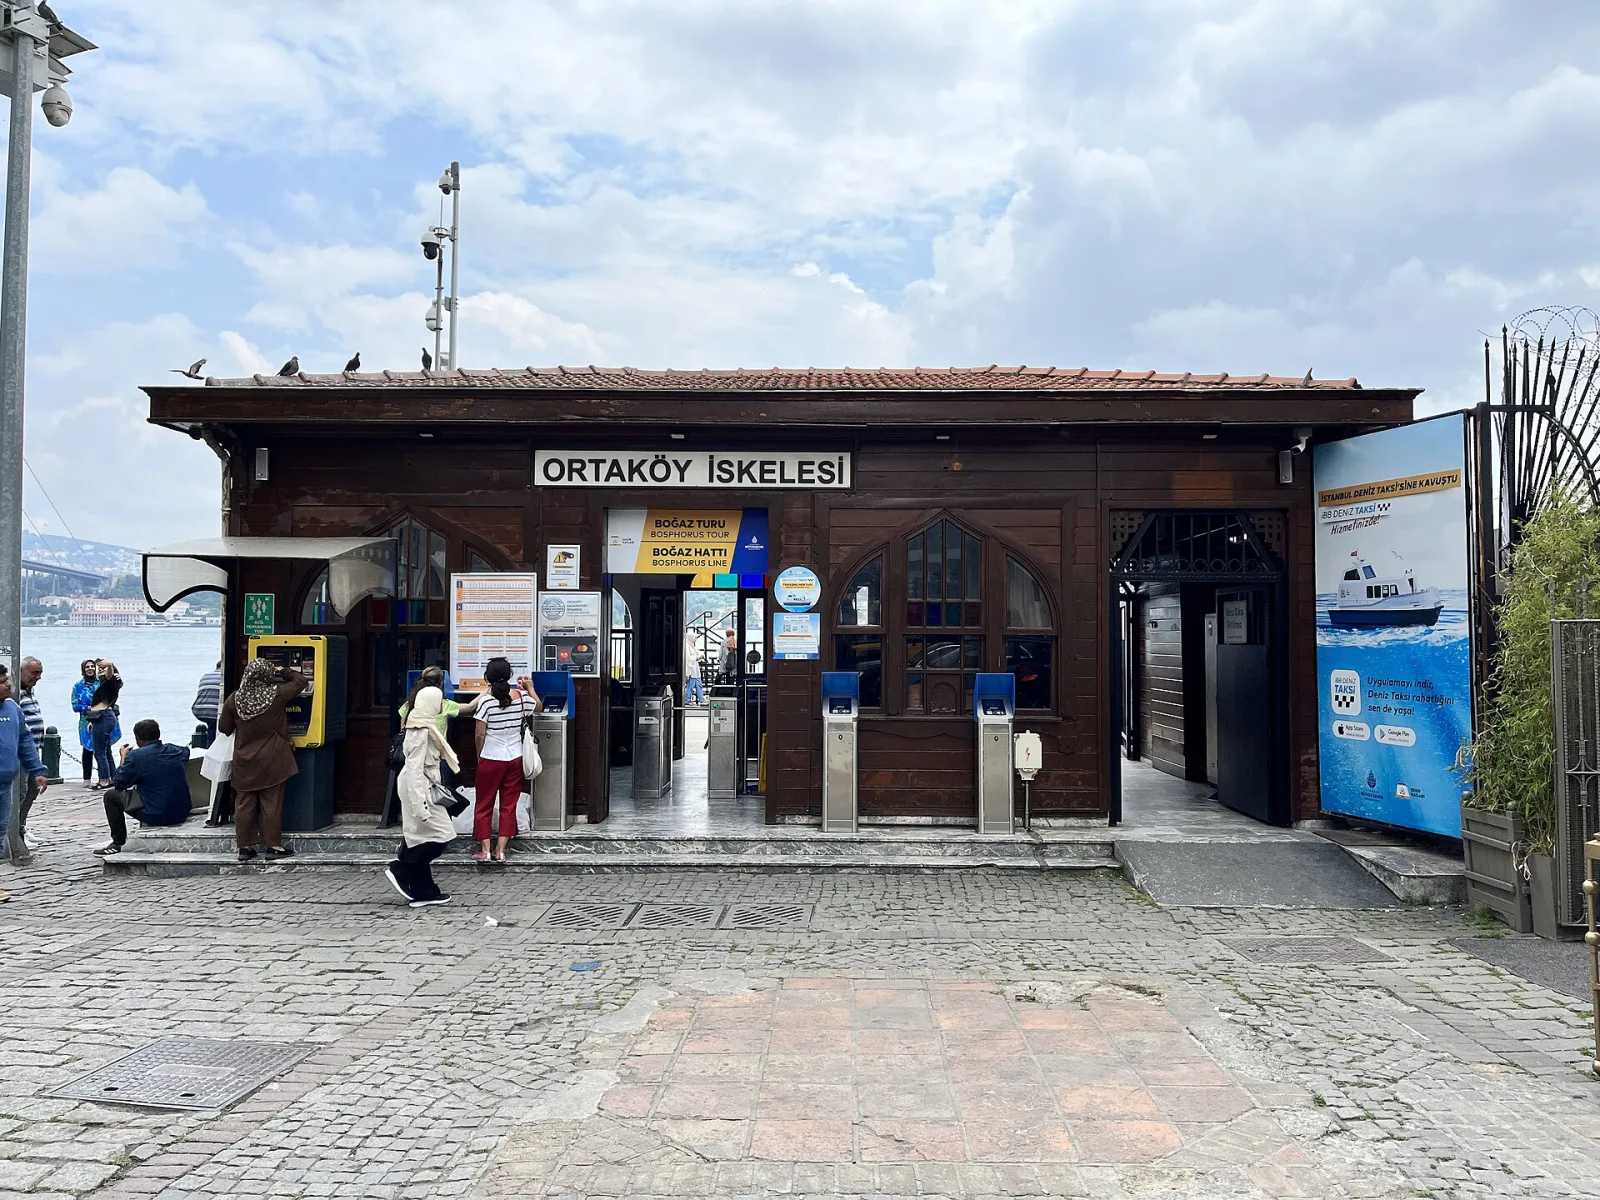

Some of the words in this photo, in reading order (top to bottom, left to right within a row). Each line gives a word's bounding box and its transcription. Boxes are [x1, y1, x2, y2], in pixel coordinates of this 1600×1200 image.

[542, 454, 693, 483] ORTAKÖY
[708, 455, 844, 485] İSKELESİ
[1321, 492, 1352, 503] İSTANBUL
[1353, 485, 1375, 498] DENİZ
[1377, 480, 1418, 495] TAKSİ'SİNE
[1419, 474, 1458, 488] KAVUŞTU
[654, 517, 694, 528] BOĞAZ
[697, 519, 726, 529] TURU
[650, 530, 705, 539] BOSPHORUS
[707, 531, 730, 539] TOUR
[652, 545, 692, 557] BOĞAZ
[694, 548, 728, 557] HATTI
[652, 559, 706, 567] BOSPHORUS
[708, 559, 728, 567] LINE
[1367, 676, 1412, 689] Uygulamayı
[1414, 679, 1434, 689] indir,
[1368, 689, 1389, 700] Deniz
[1391, 691, 1411, 701] Taksi
[1412, 693, 1455, 706] rahatlığını
[1383, 704, 1392, 713] de
[1393, 705, 1415, 716] yaşa!
